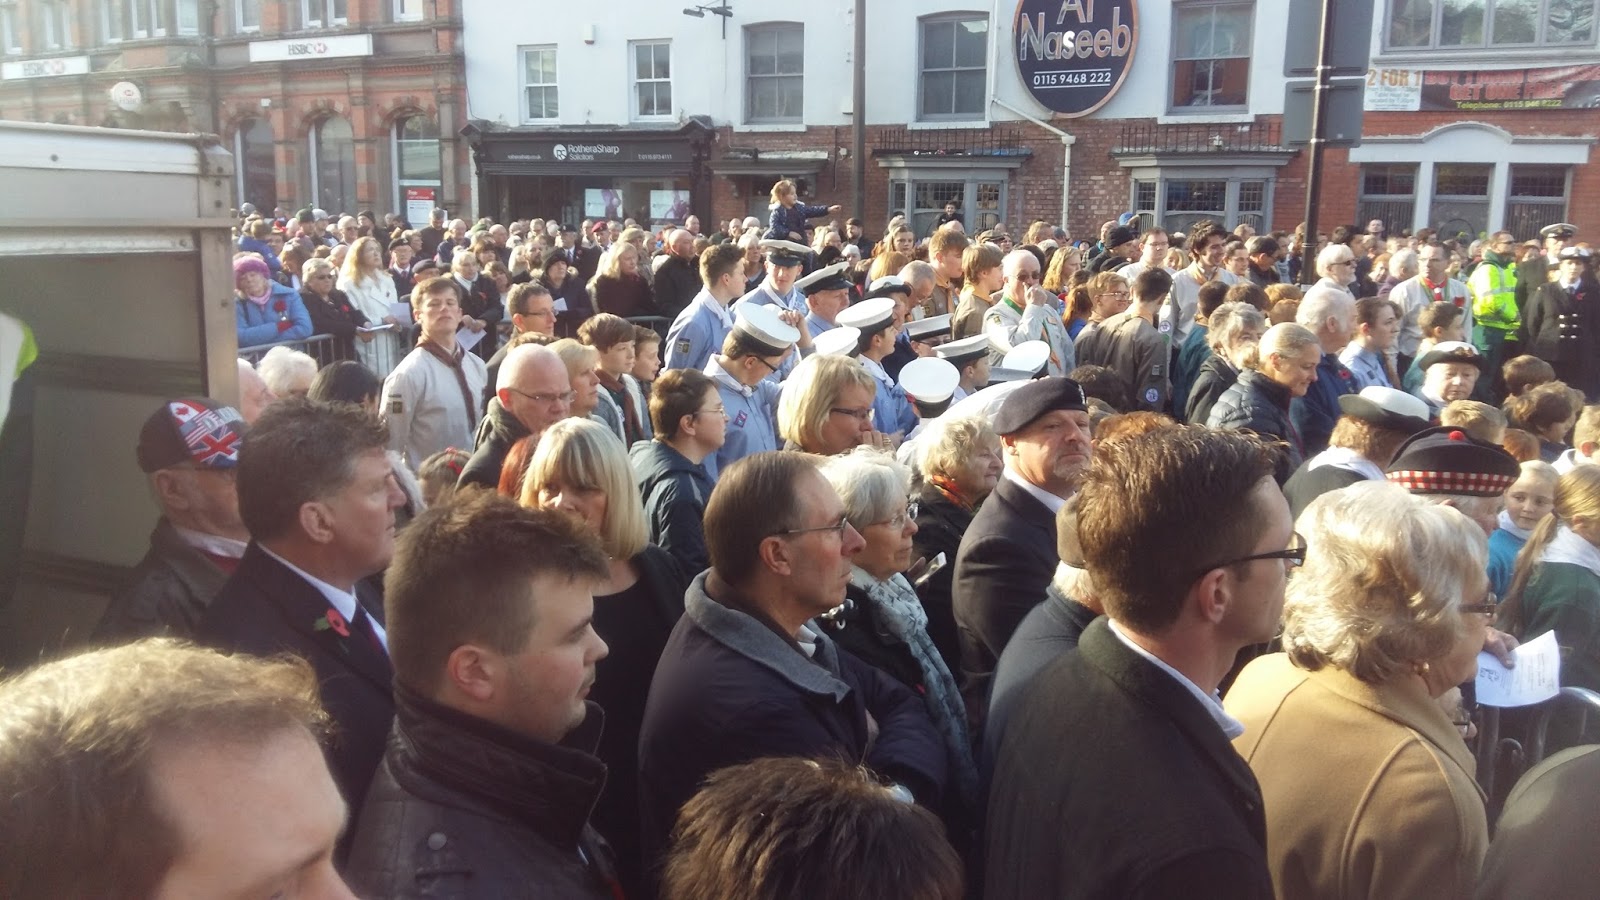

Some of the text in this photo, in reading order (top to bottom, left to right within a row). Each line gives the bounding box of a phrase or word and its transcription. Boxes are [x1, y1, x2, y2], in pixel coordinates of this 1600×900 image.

[1020, 6, 1132, 61] Naseeb
[287, 43, 313, 55] HSBC
[1033, 72, 1111, 85] 0115 9468 222
[1367, 69, 1421, 86] 2 FOR 1
[1449, 81, 1567, 100] GET ONE FREE
[1456, 101, 1501, 109] Telephone:
[1503, 100, 1523, 108] 0115
[568, 144, 619, 155] RotheraSharp
